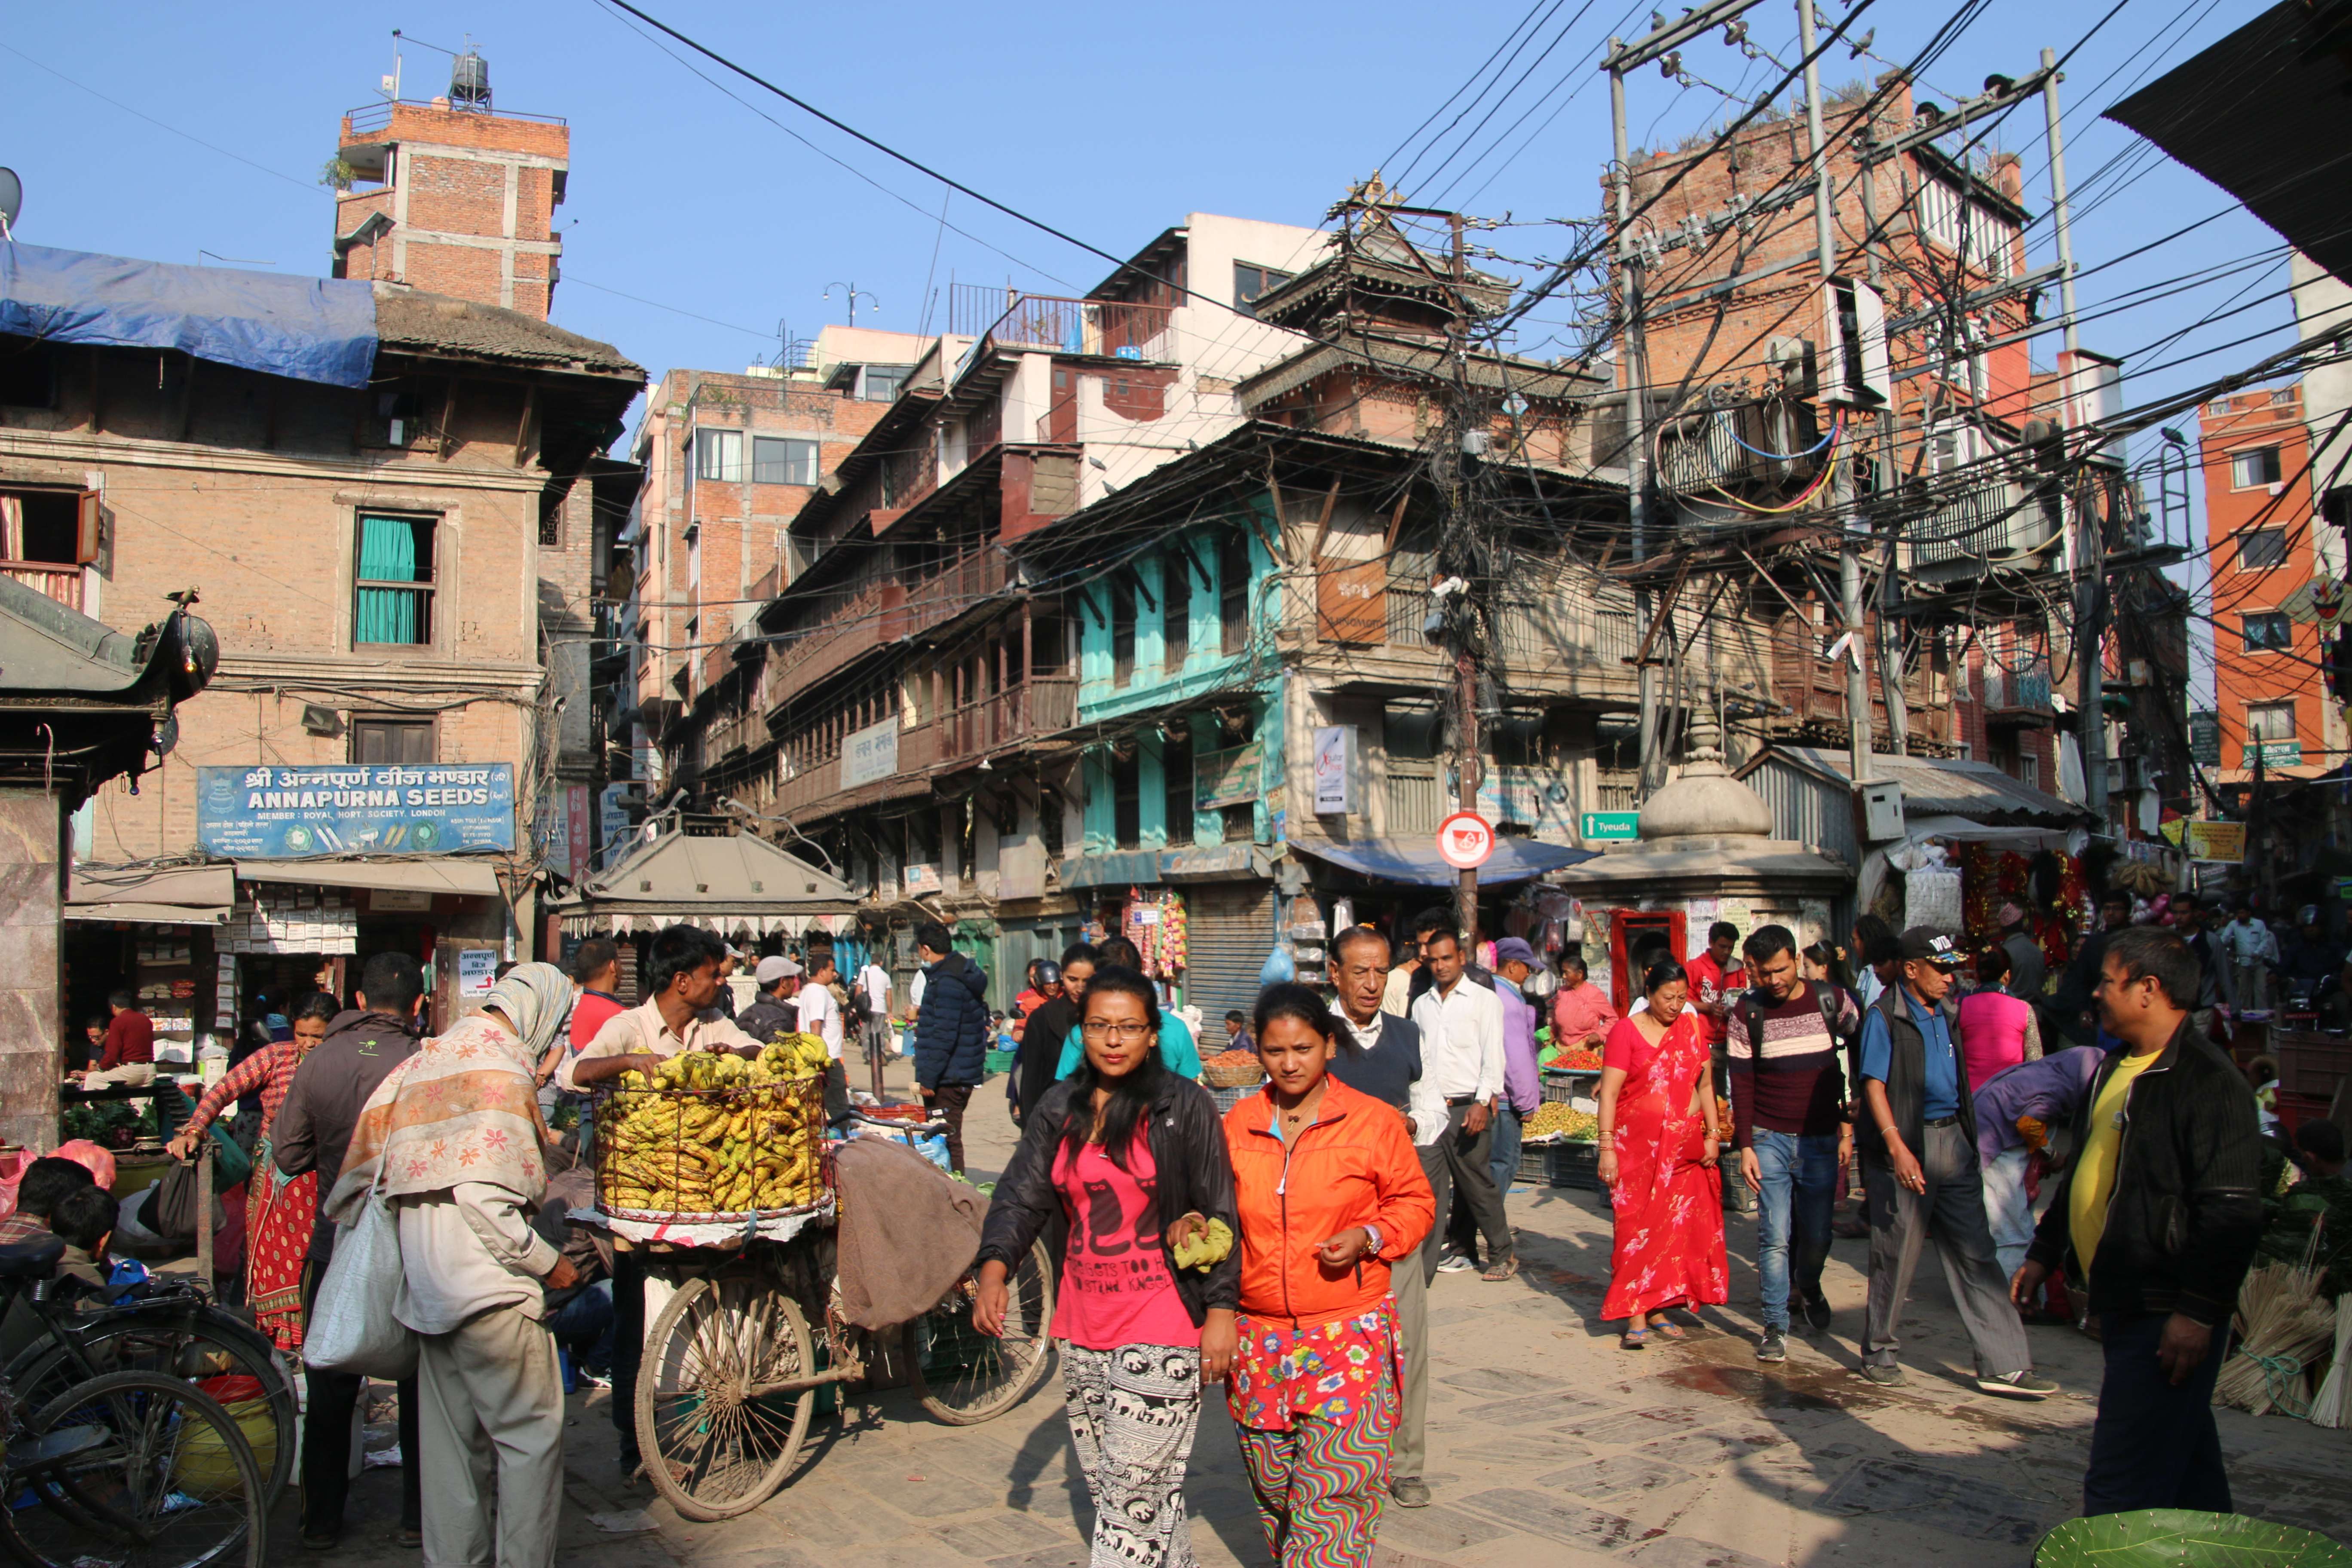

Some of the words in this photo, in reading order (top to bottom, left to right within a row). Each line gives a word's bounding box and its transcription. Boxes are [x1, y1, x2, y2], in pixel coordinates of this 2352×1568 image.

[1485, 766, 1508, 775] NGLISH
[245, 767, 273, 788] श्री
[428, 770, 490, 786] भण्डार
[248, 789, 401, 808] ANNAPURNA
[407, 788, 488, 806] SEEDS
[1598, 822, 1630, 833] Tyeuda
[461, 951, 495, 961] अन्नपूर्ण
